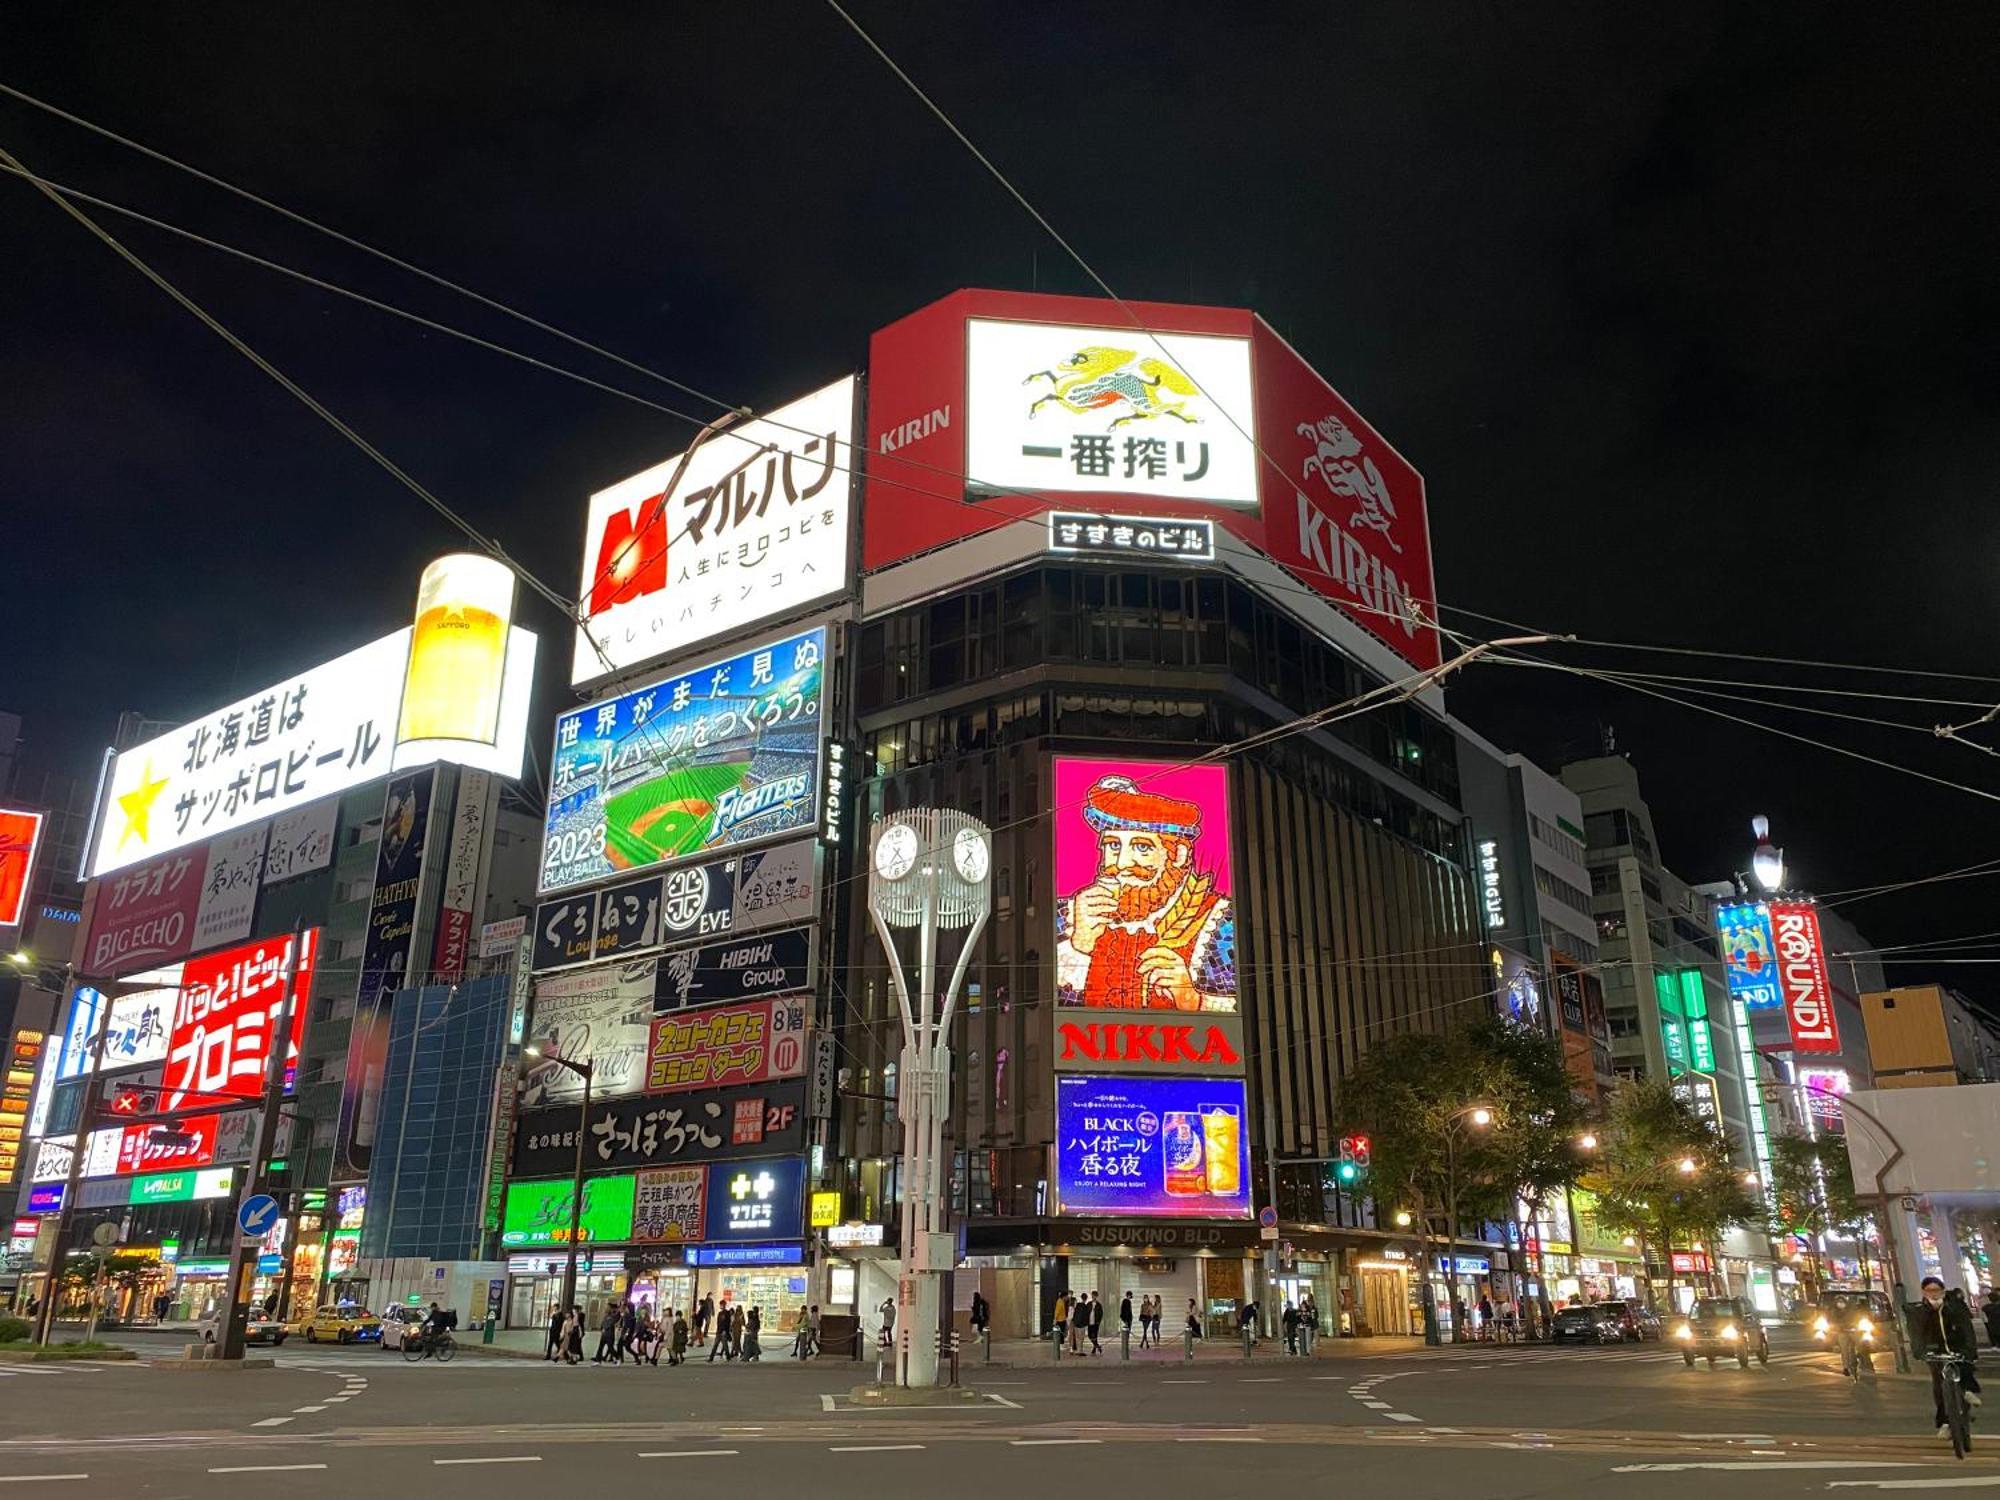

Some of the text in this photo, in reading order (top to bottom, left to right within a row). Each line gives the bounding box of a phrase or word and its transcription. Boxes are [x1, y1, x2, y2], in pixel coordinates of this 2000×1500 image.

[880, 405, 950, 454] KIRIN
[1022, 434, 1210, 481] 一番搾り
[684, 431, 836, 545] マルハン
[678, 509, 834, 584] 人生にヨロコビを
[1060, 523, 1203, 549] すすきのビル
[1296, 491, 1414, 639] KIRIN
[599, 562, 817, 650] 新しいパチンコへ
[560, 640, 819, 748] 世界がまだ見ぬ
[183, 683, 309, 773] 北海道は
[555, 691, 816, 787] ボールパークをつくろう。
[175, 720, 380, 835] サッポロビール
[705, 772, 810, 844] FIGHTERS
[547, 824, 607, 868] 2023
[108, 856, 192, 910] カラオケ
[544, 858, 601, 886] PLAY BALL
[93, 929, 131, 969] BIG
[131, 911, 185, 951] ECHO
[443, 911, 465, 970] カラオケ
[700, 909, 731, 934] EVE
[566, 934, 618, 957] Lounge
[720, 944, 773, 969] HIBIKI
[742, 968, 785, 988] Group
[1777, 914, 1833, 1041] ROUND1
[654, 1014, 765, 1056] ネットカフェ
[773, 1005, 803, 1032] 8階
[1057, 1022, 1240, 1065] NIKKA
[651, 1054, 711, 1087] コミック
[592, 1103, 722, 1160] さっぽろっこ
[766, 1105, 794, 1131] 2F
[1084, 1117, 1135, 1132] BLACK
[1067, 1135, 1152, 1154] ハイボール
[1080, 1153, 1142, 1177] 香る夜
[638, 1184, 695, 1203] 元祖串かつ
[1081, 1227, 1225, 1244] SUSUKINO BLD.
